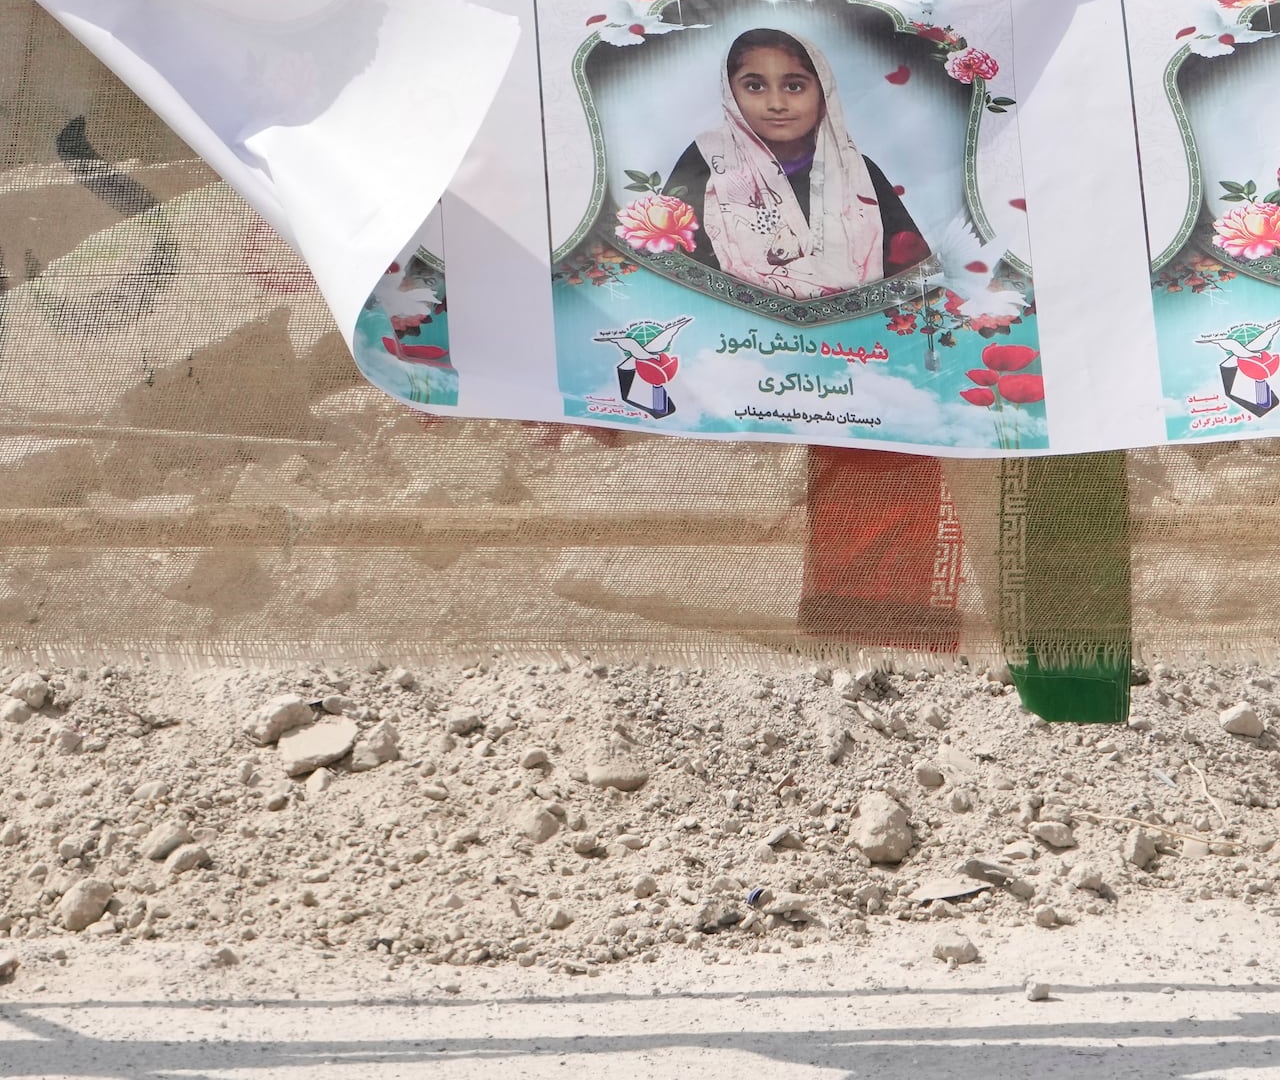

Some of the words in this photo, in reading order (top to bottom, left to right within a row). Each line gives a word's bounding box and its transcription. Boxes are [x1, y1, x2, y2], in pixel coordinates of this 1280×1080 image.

[821, 342, 889, 364] شهیده
[758, 373, 814, 396] ذاکری
[818, 376, 853, 398] اسرا
[735, 406, 772, 420] میناب
[773, 409, 801, 421] طیبه
[803, 411, 835, 423] شجره
[837, 412, 882, 427] دبستان
